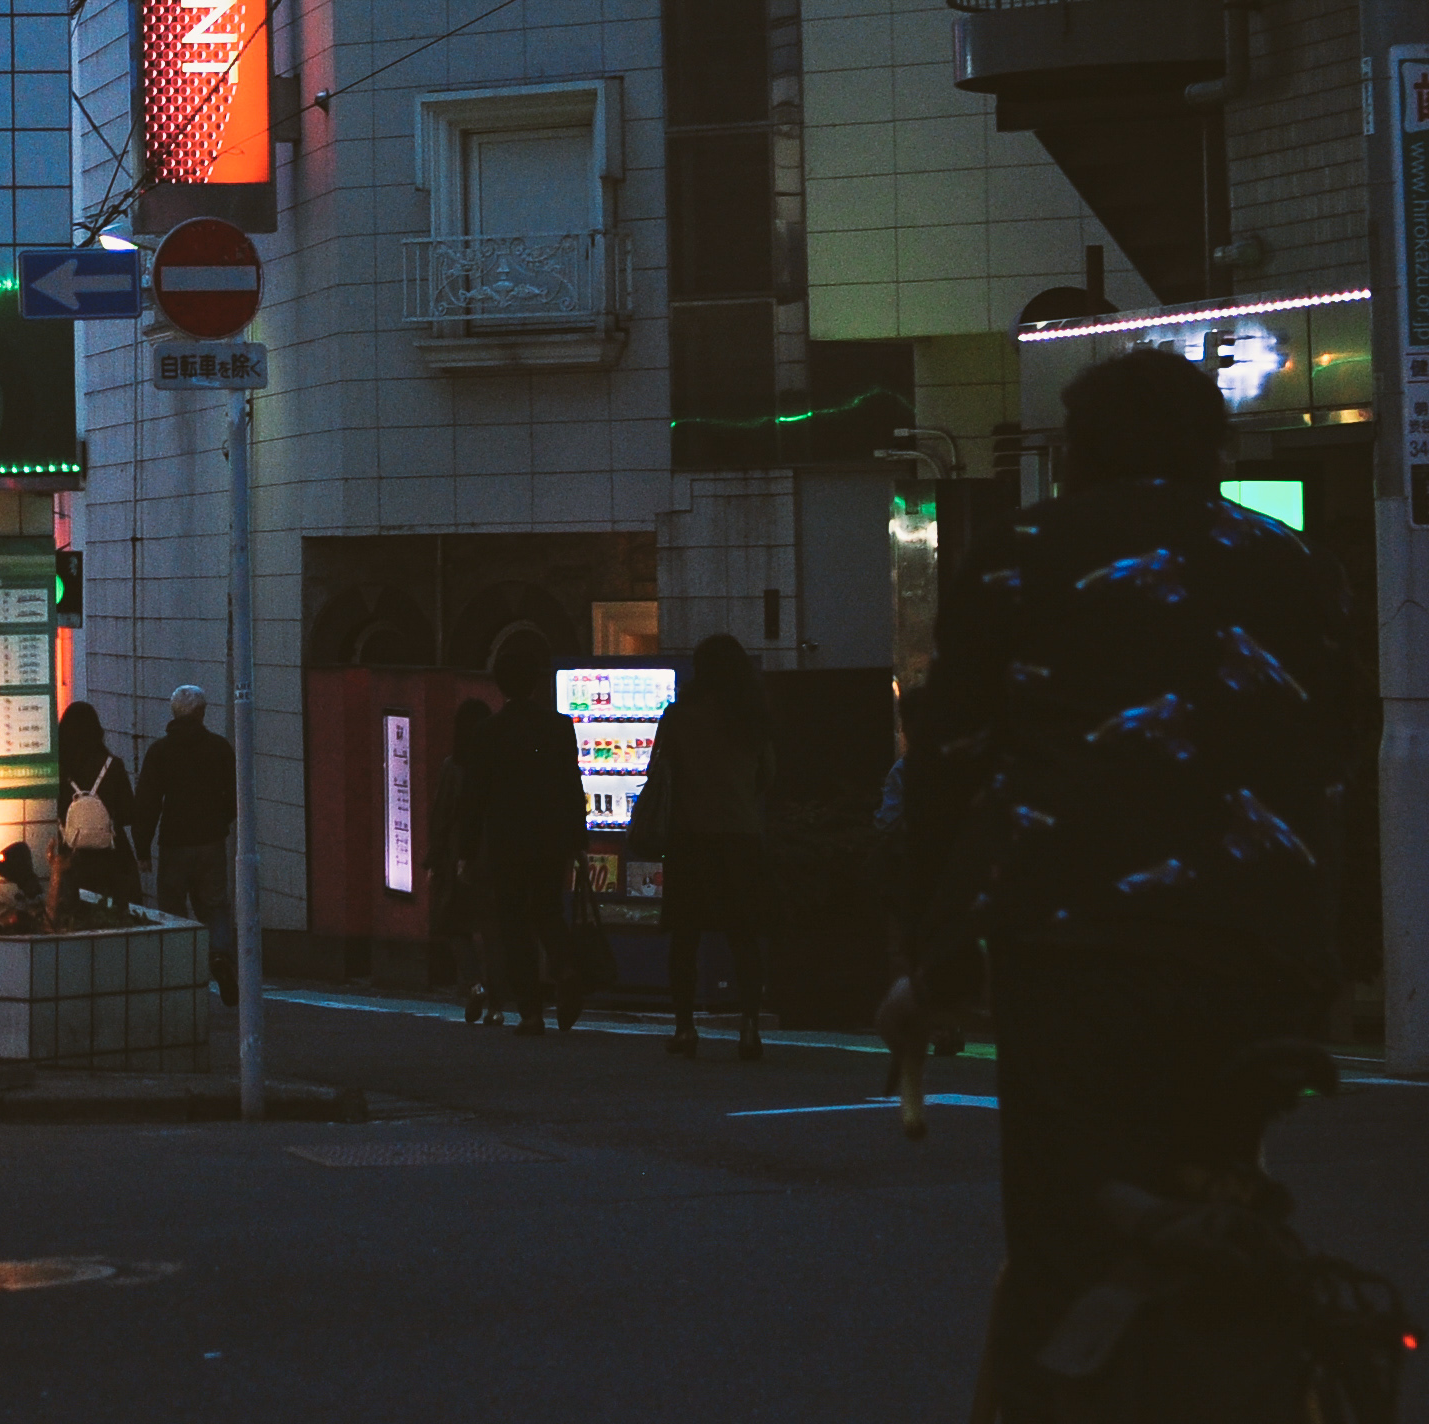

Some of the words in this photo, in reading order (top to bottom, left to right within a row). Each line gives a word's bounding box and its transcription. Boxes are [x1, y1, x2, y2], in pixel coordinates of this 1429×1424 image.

[160, 354, 262, 378] 自転車を除く
